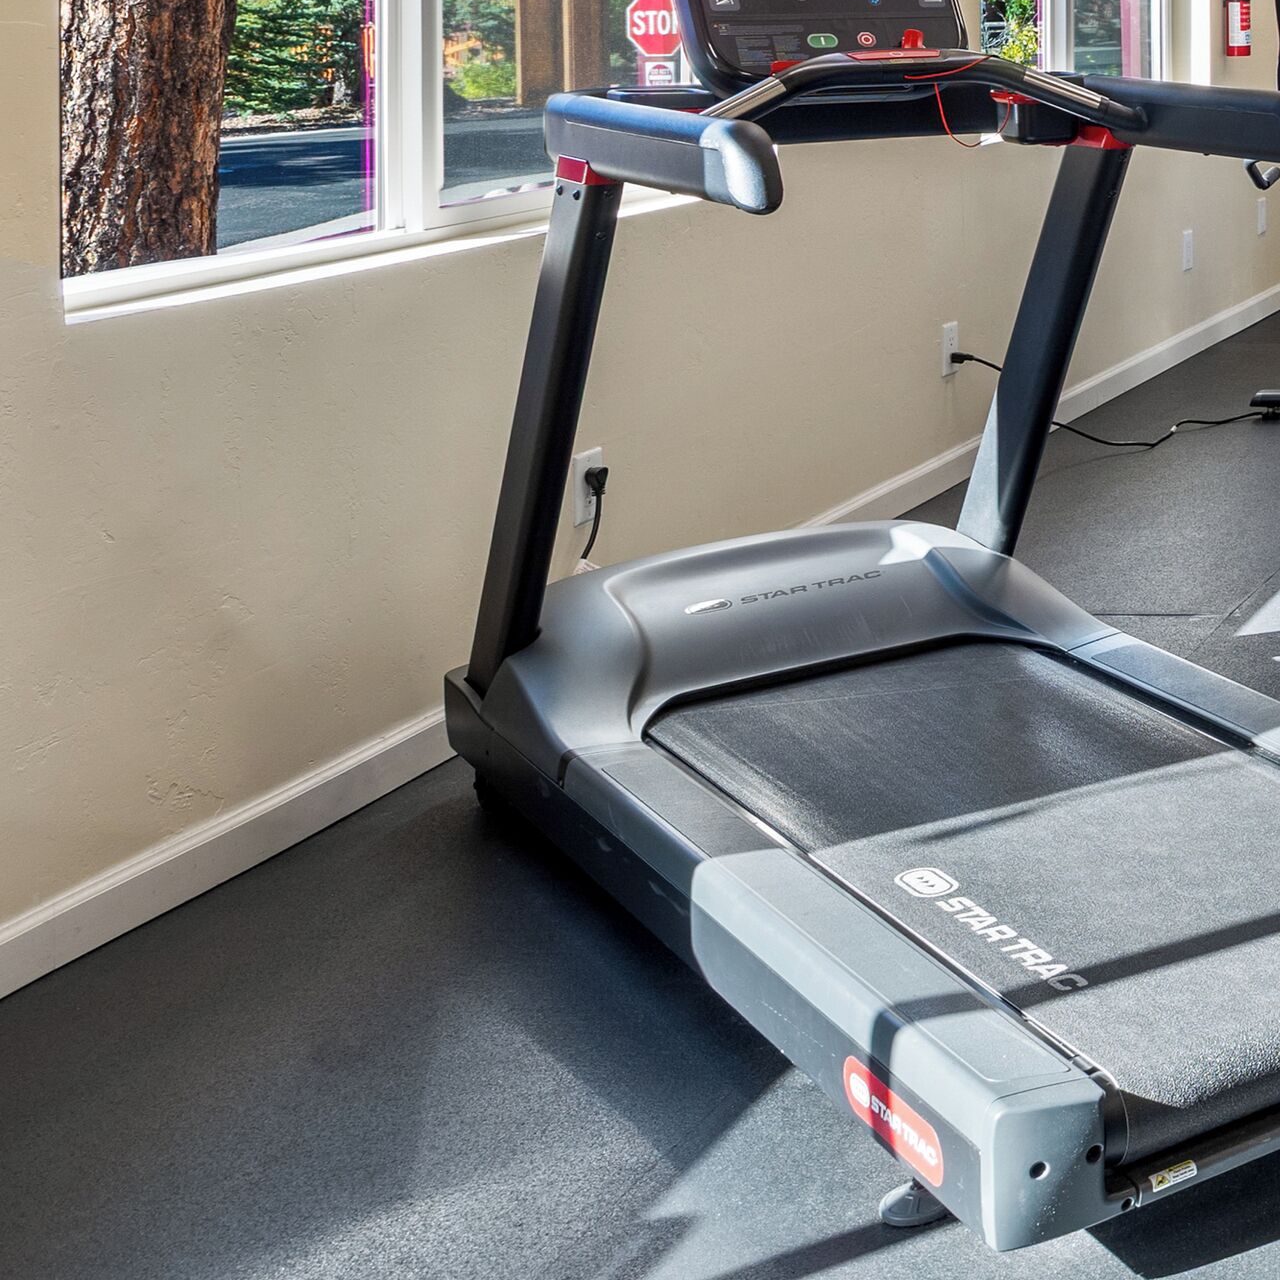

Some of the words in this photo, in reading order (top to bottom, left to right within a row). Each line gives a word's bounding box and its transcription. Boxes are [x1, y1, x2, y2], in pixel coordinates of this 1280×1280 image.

[740, 585, 808, 604] STAR
[811, 570, 881, 588] TRAC
[936, 896, 1018, 943] STAR
[1001, 938, 1089, 991] TRAC
[871, 1095, 901, 1135] STAR
[902, 1122, 938, 1166] TRAC
